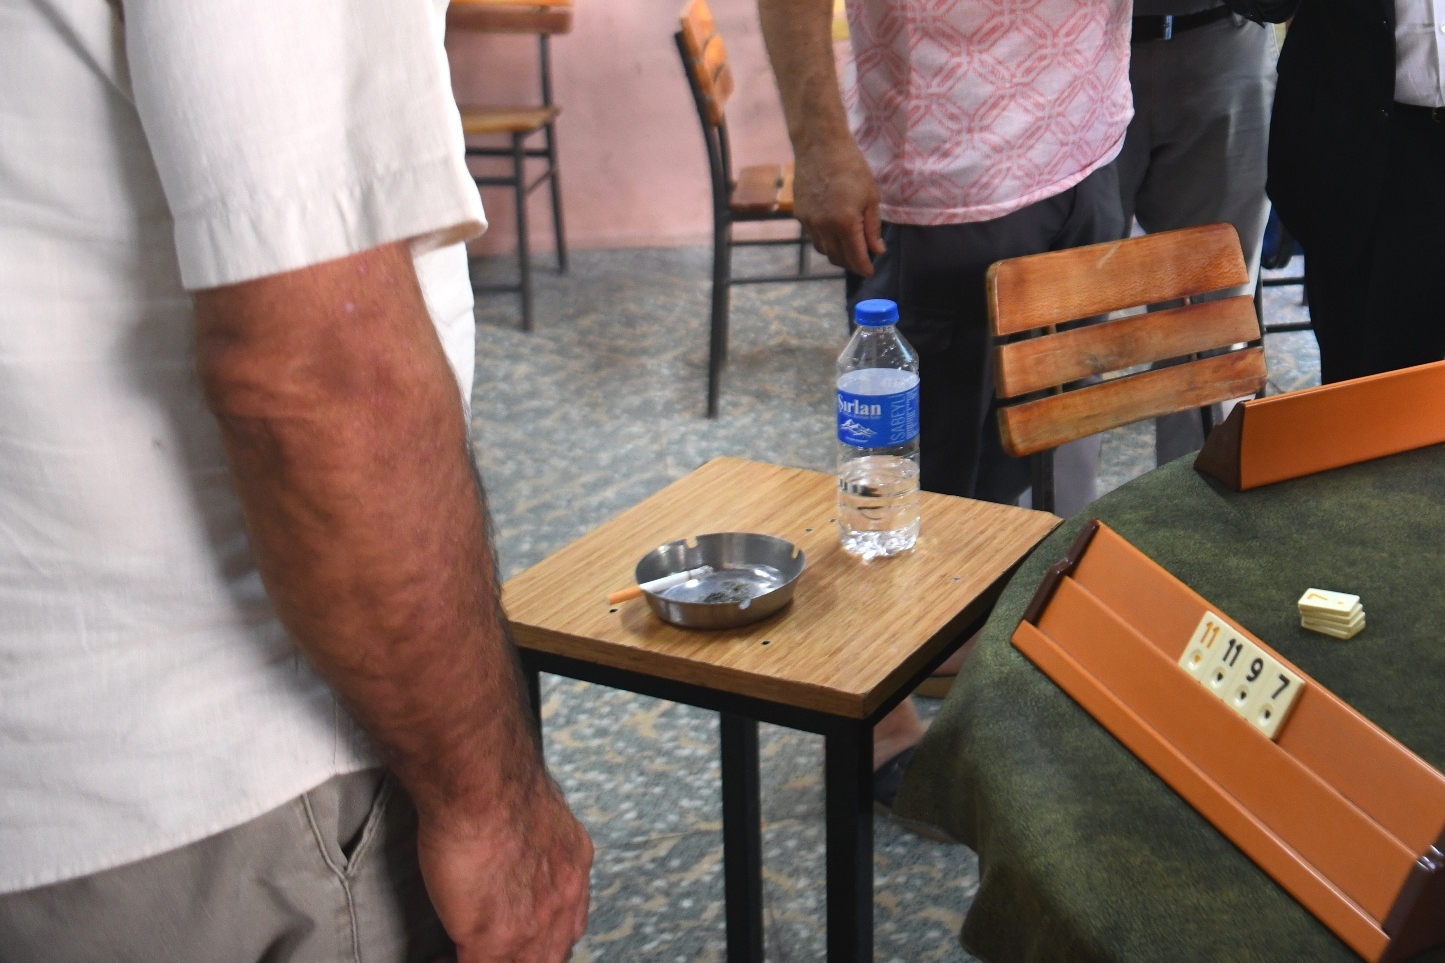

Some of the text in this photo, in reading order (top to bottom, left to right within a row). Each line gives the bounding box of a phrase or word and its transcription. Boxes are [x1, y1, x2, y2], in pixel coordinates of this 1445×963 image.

[1200, 621, 1291, 700] 11 11 9 7
